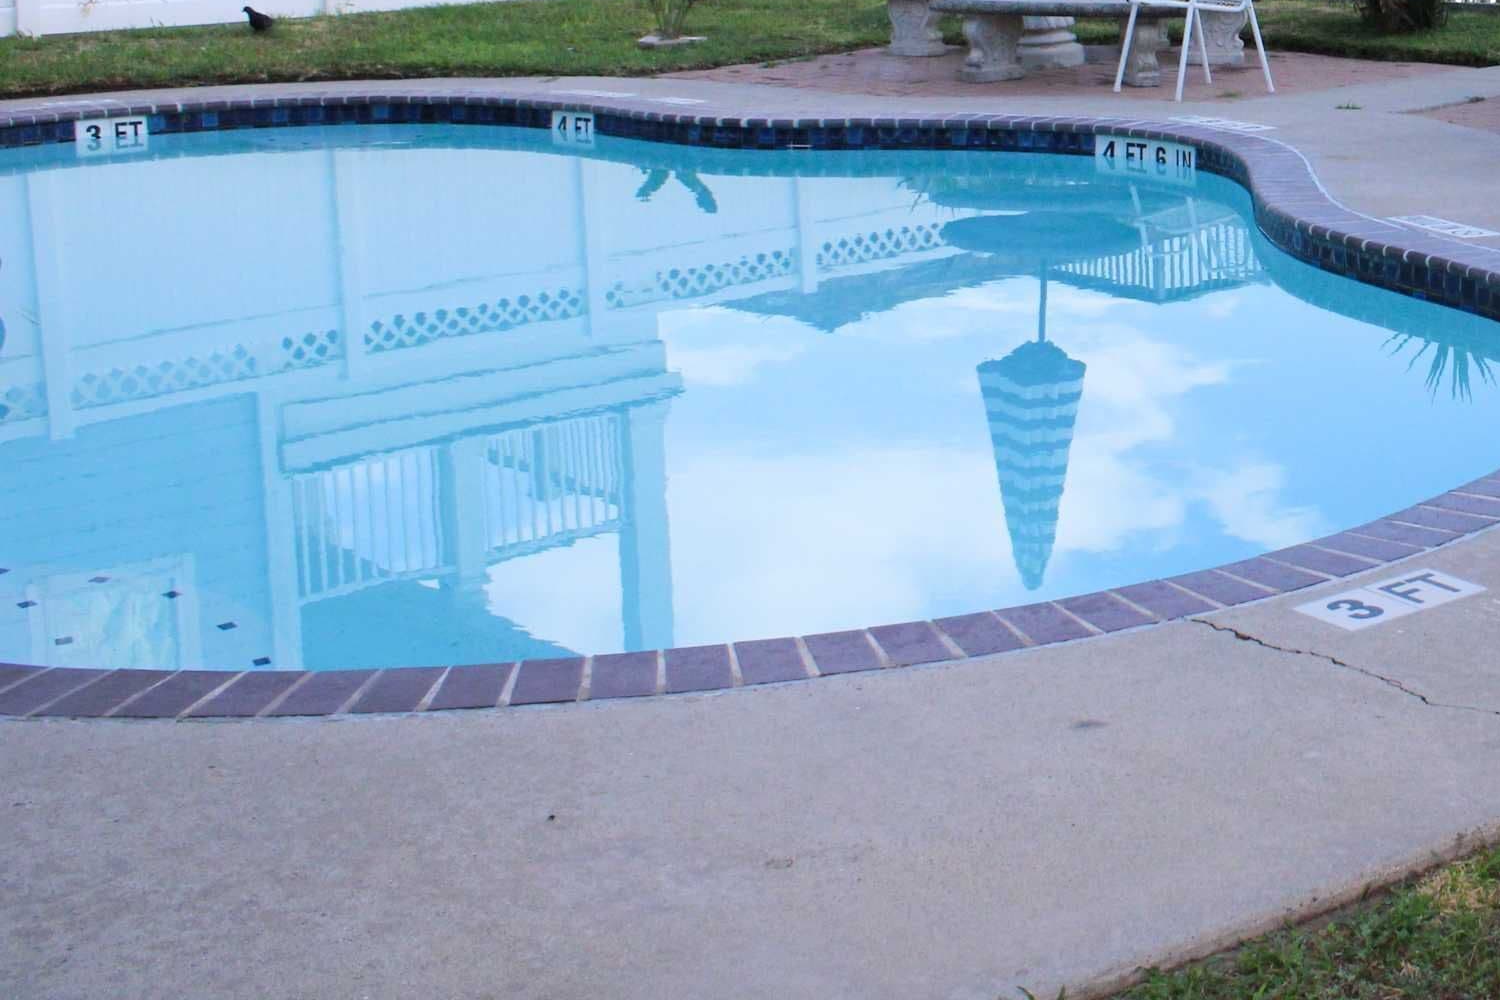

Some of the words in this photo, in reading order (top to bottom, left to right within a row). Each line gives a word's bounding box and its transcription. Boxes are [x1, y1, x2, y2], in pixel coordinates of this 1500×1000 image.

[86, 124, 101, 142] 3
[115, 120, 143, 141] FT
[575, 116, 592, 135] FT
[1126, 142, 1147, 161] FT
[1176, 149, 1192, 169] IN
[1326, 598, 1385, 620] 3
[1378, 572, 1462, 604] FT
